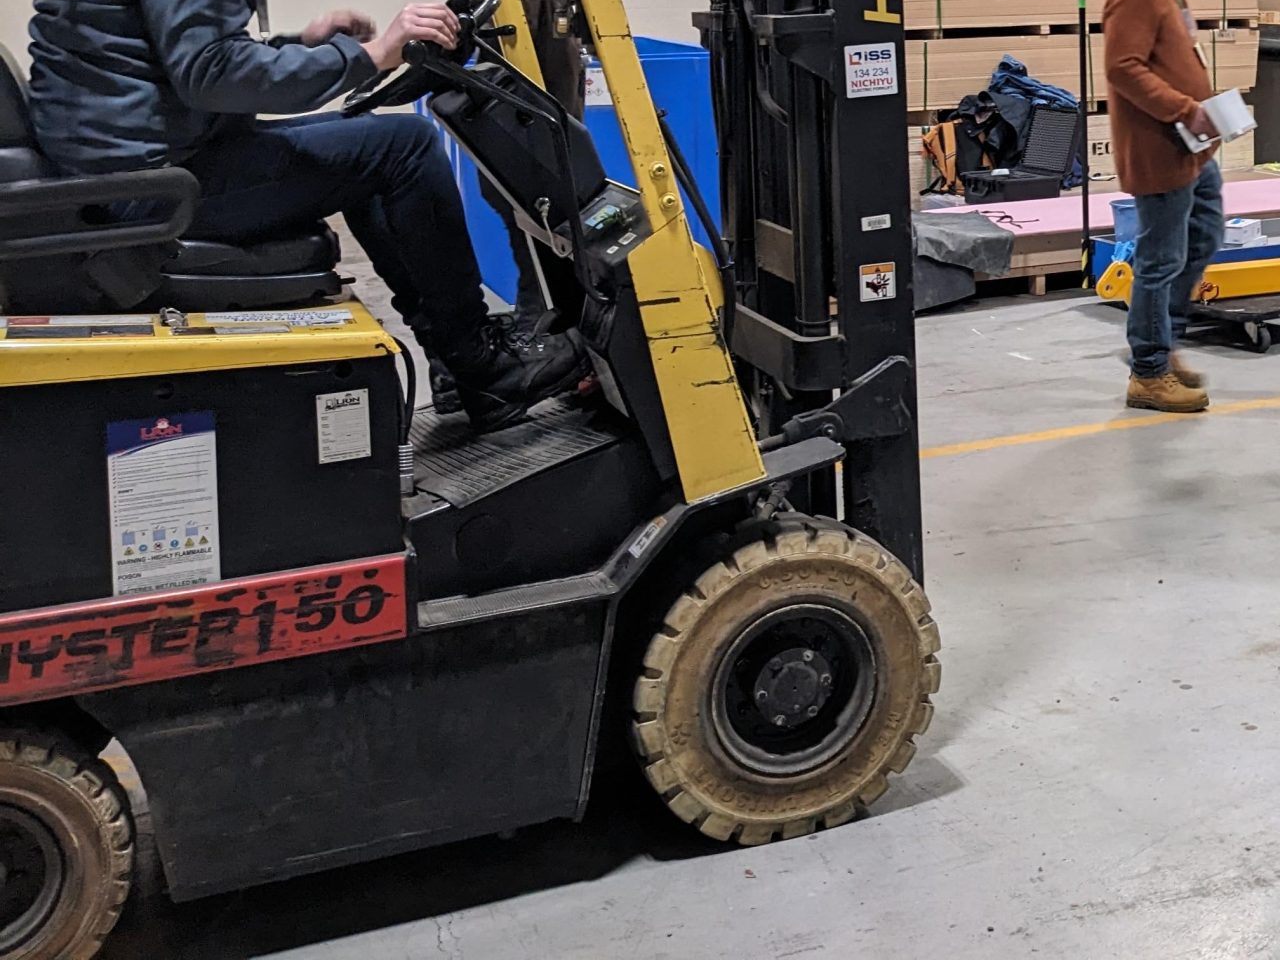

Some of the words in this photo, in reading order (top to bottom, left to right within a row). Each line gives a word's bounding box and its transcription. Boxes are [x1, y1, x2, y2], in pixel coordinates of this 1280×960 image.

[854, 69, 870, 78] 134
[872, 67, 889, 77] 234
[851, 77, 893, 88] NICHIYU
[175, 546, 212, 558] FLAMMABLE
[0, 607, 240, 685] YSTER
